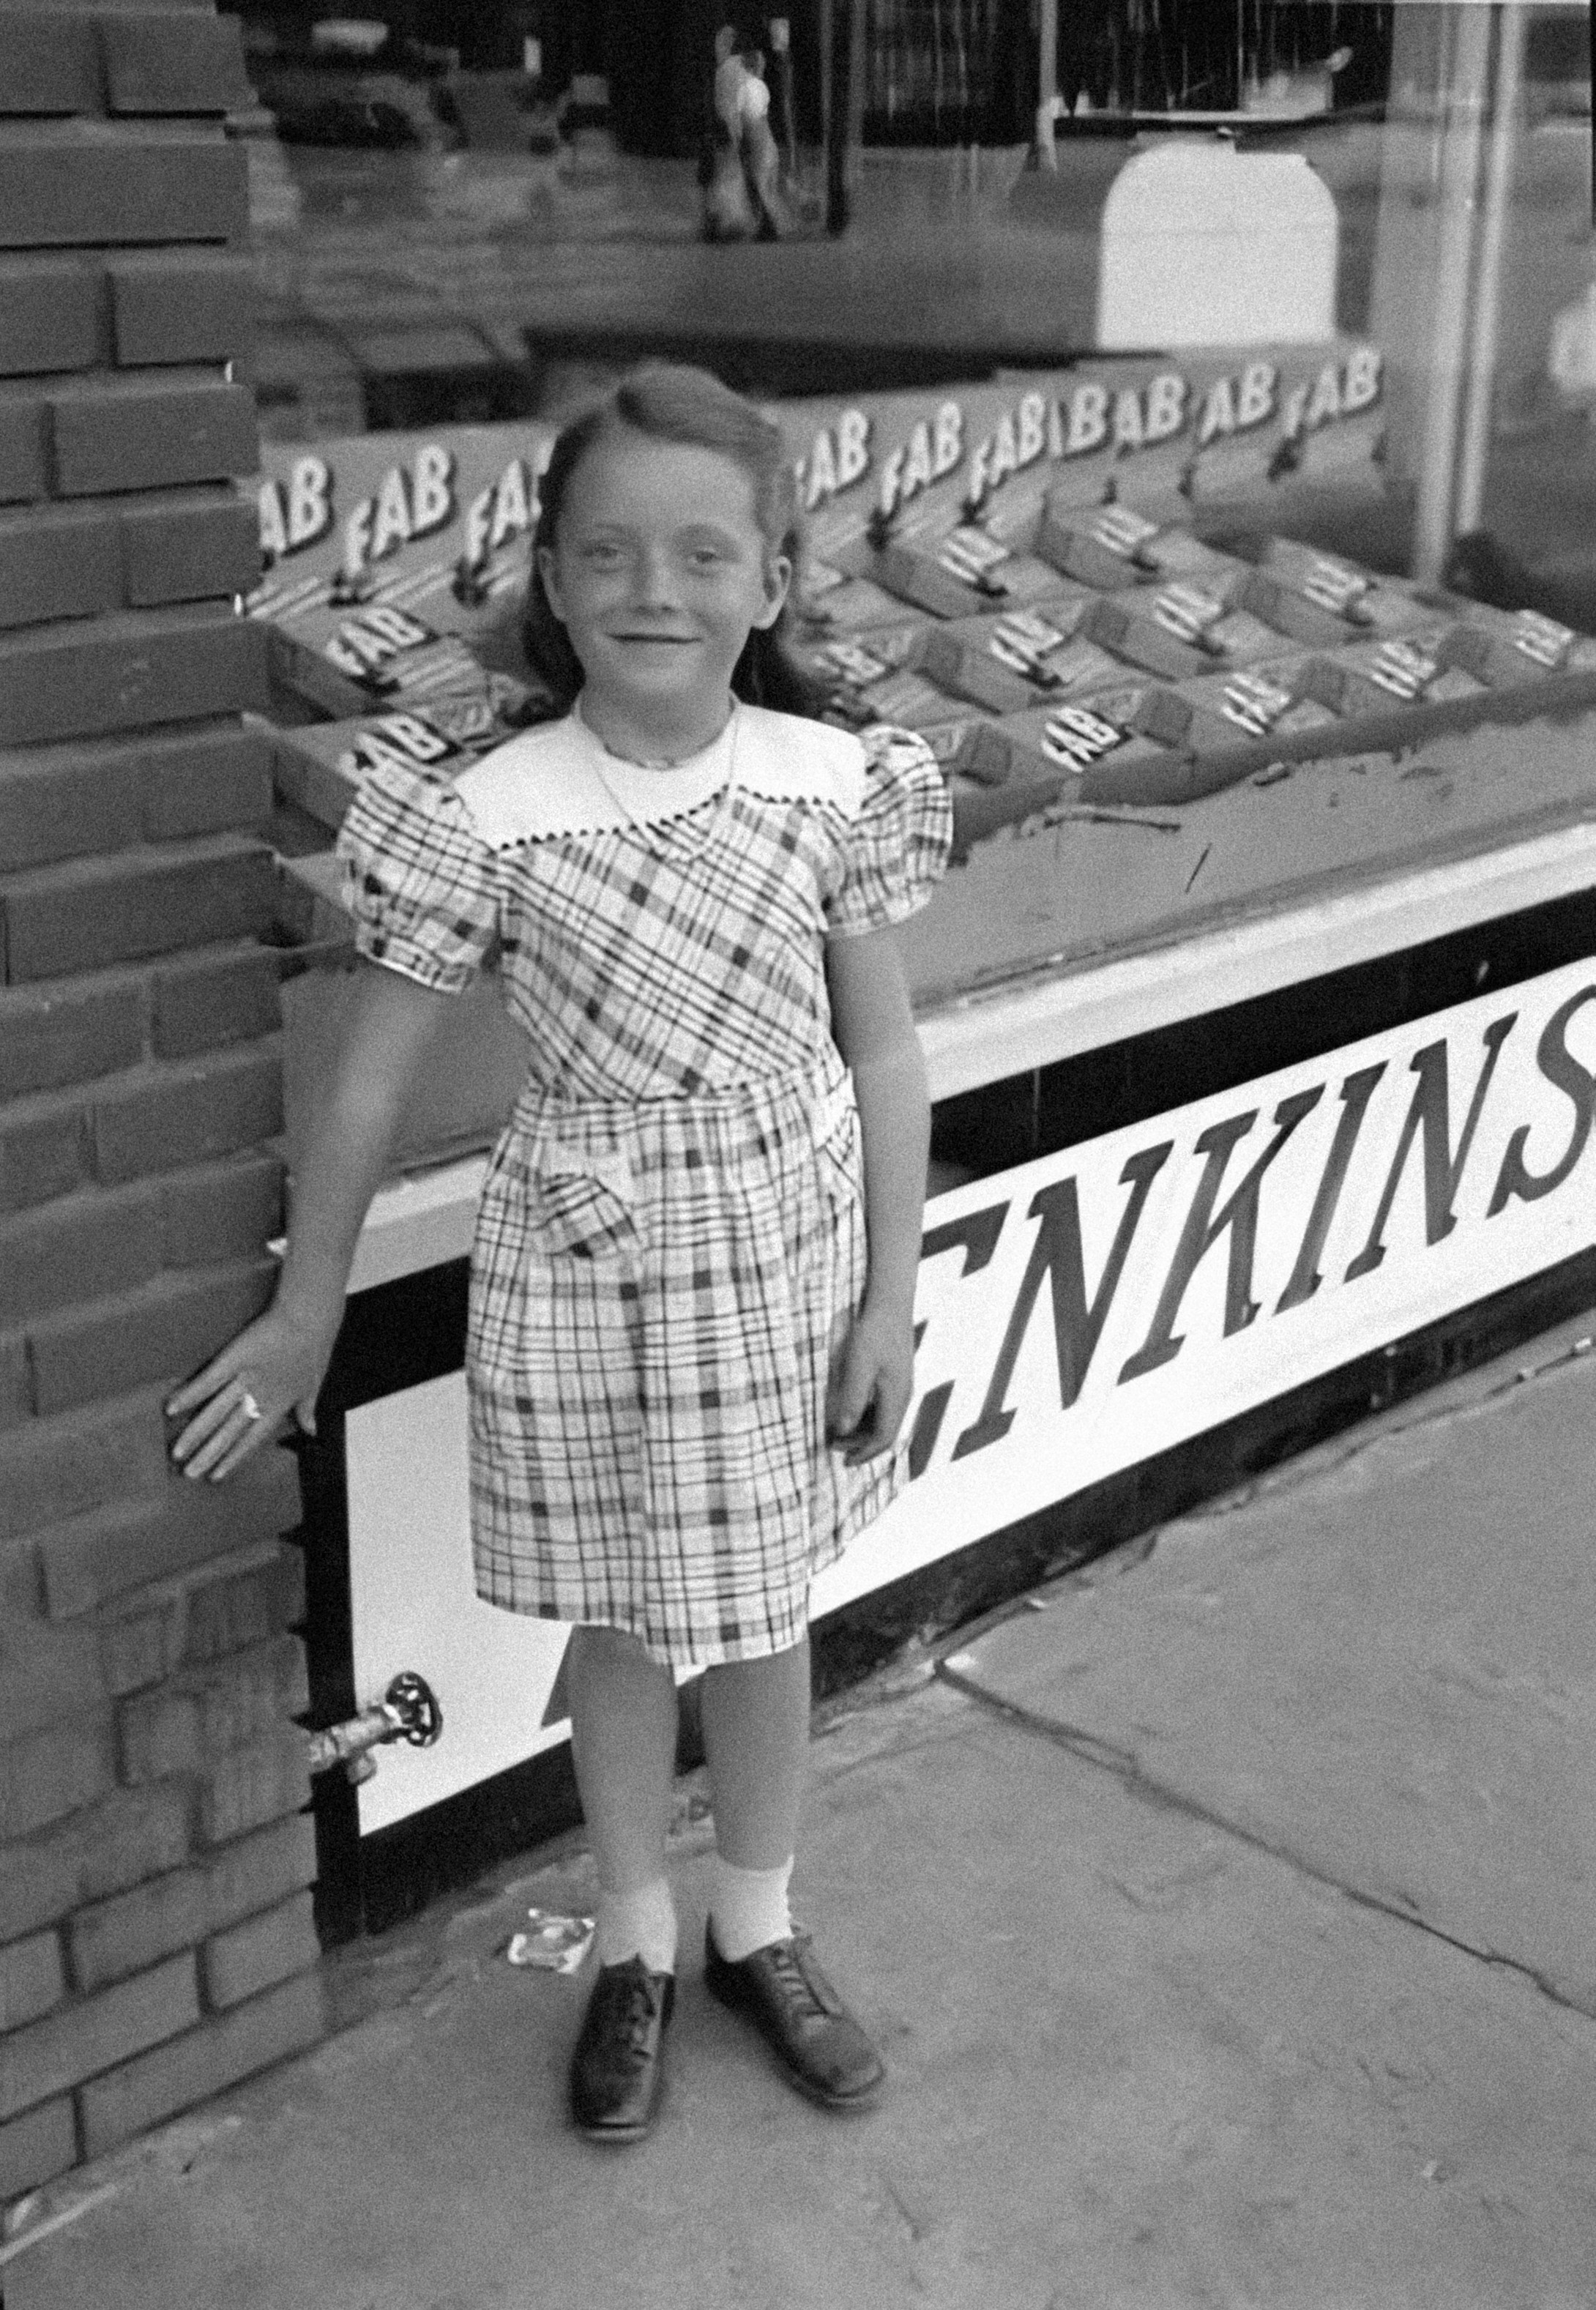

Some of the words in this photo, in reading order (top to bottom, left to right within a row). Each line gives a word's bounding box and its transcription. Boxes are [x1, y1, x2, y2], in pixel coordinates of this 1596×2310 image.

[970, 391, 1045, 502] FAB
[1115, 374, 1185, 446] AB
[1199, 364, 1275, 443] AB
[258, 454, 329, 554] AB
[795, 408, 869, 508] AB
[881, 400, 962, 513] FAB
[346, 443, 452, 578] FAB
[466, 458, 544, 562] FA
[324, 606, 426, 675] FAB
[1039, 705, 1120, 773] FAB
